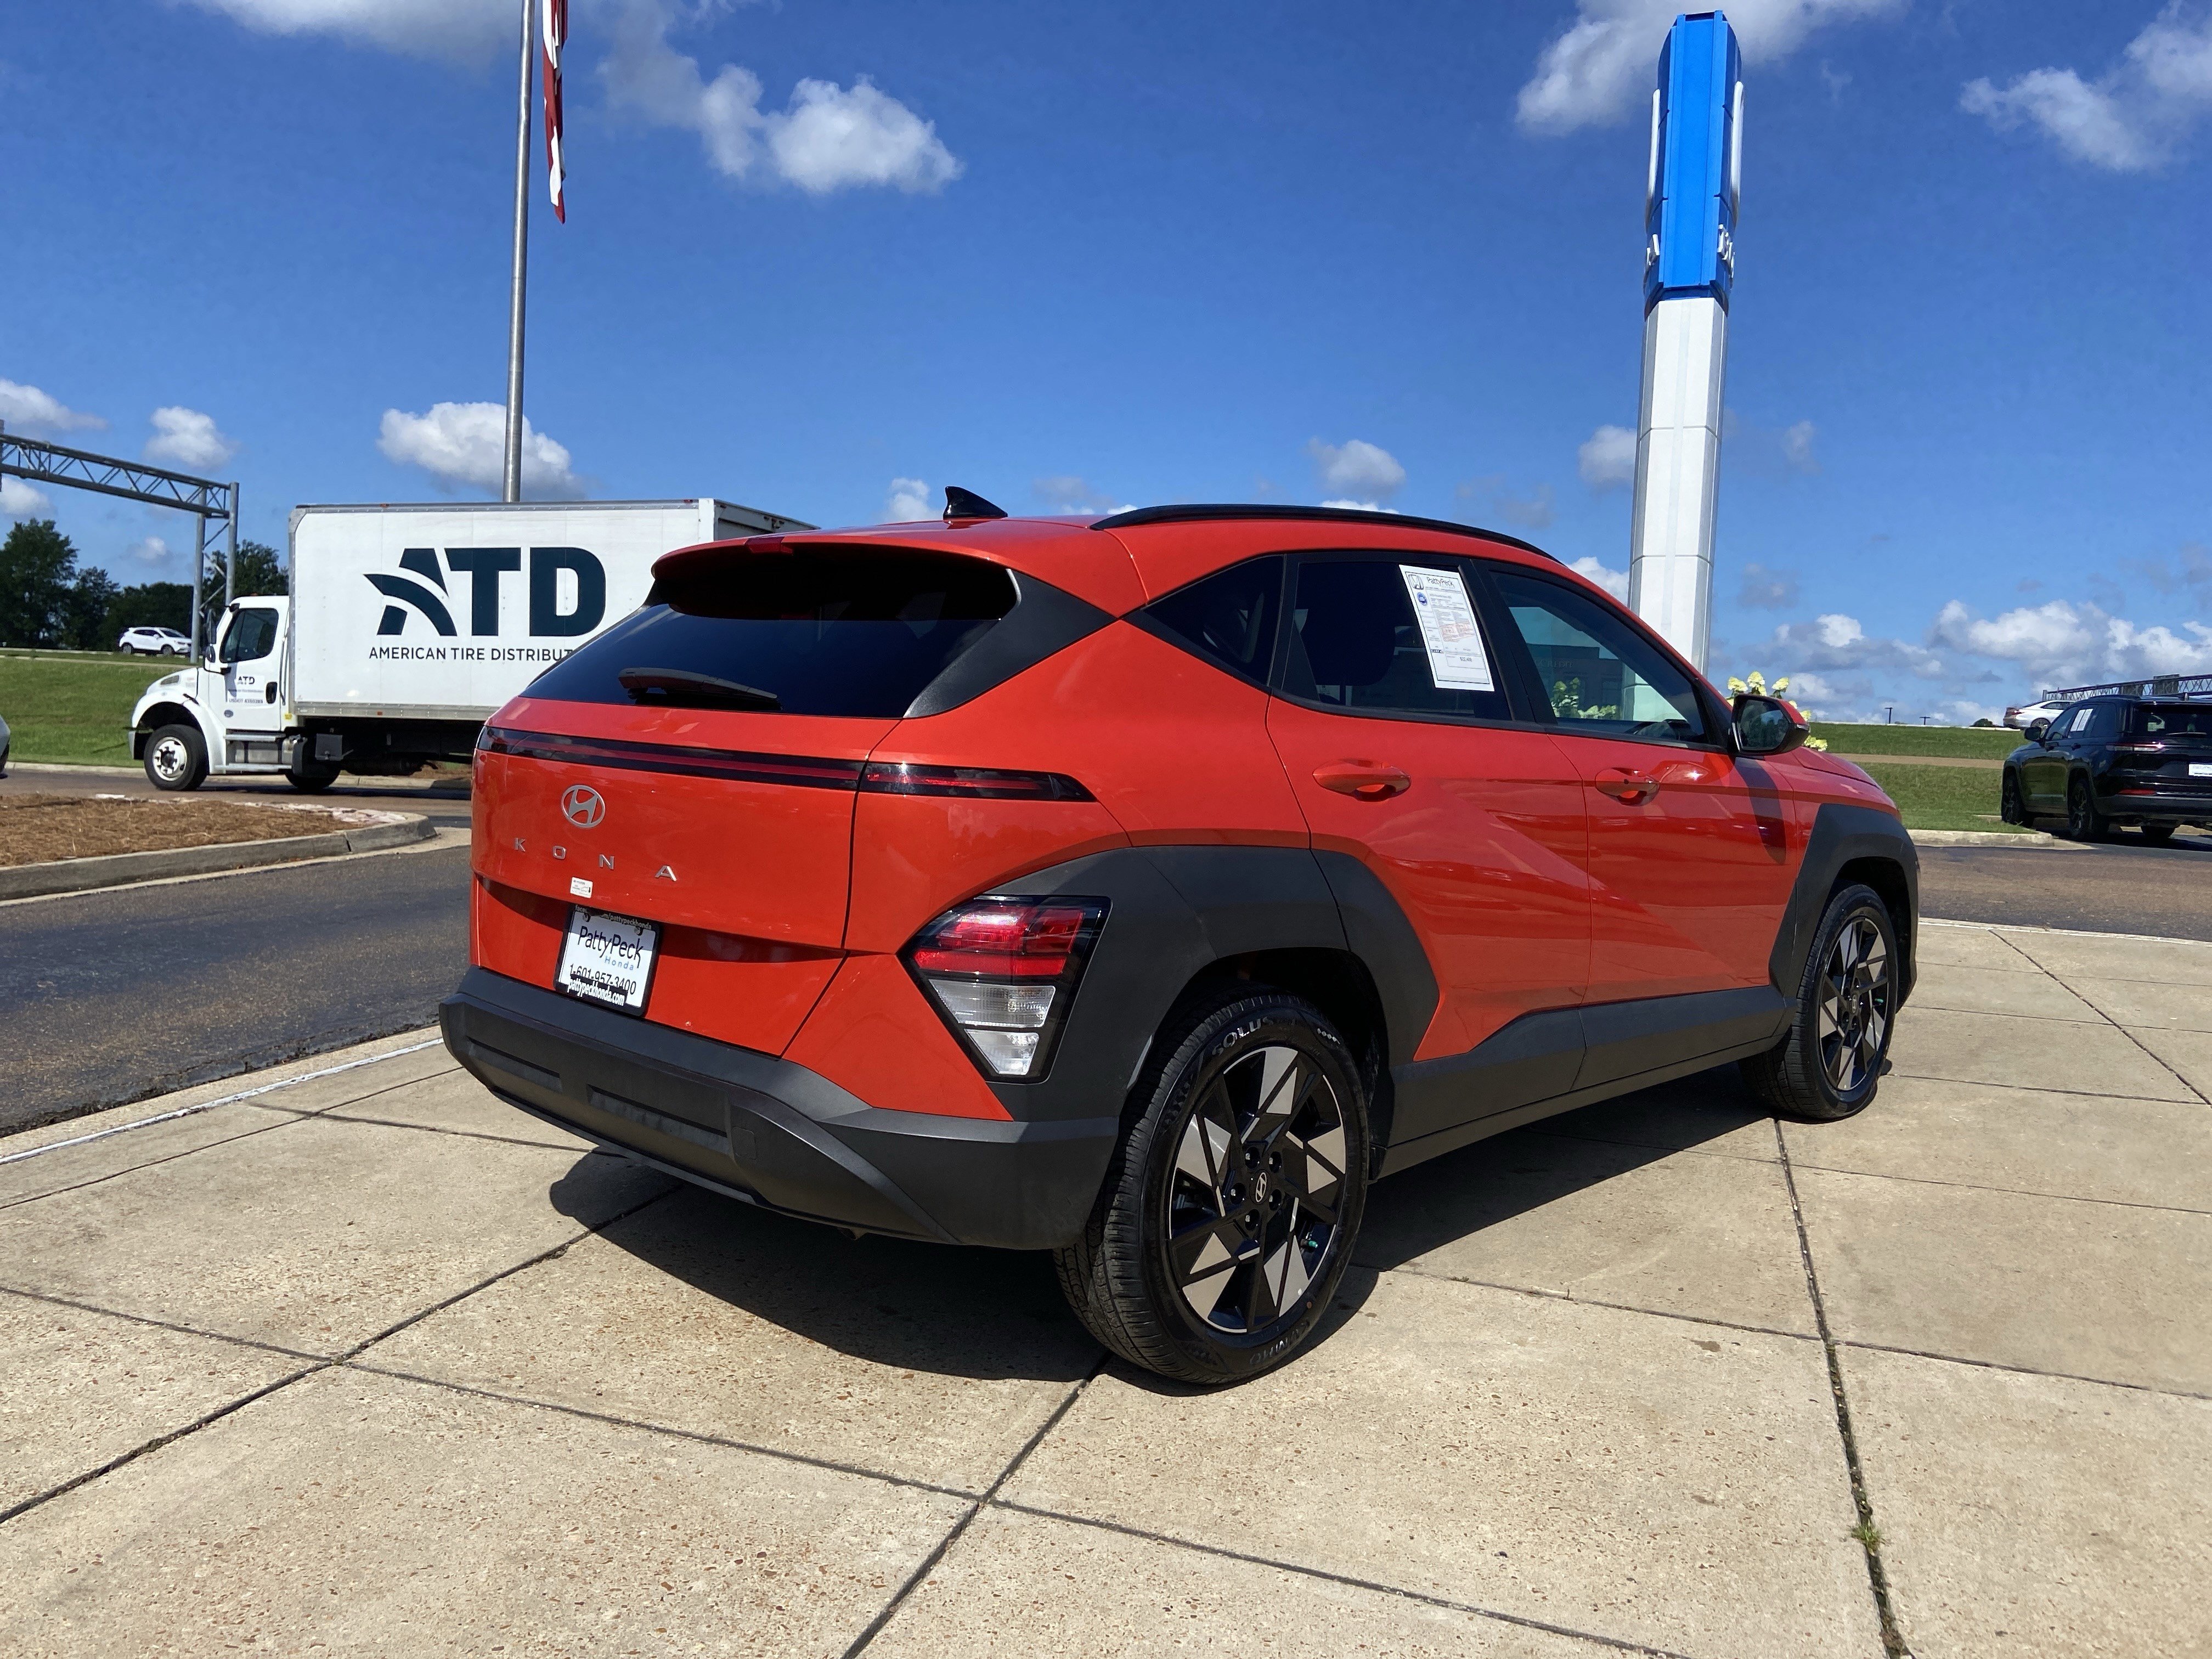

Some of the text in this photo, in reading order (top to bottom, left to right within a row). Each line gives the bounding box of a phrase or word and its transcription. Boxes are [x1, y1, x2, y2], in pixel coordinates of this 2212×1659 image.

[364, 547, 606, 636] ATD
[369, 647, 446, 660] AMERICAN
[451, 648, 485, 661] TIRE
[237, 676, 255, 685] ATD
[514, 837, 678, 882] KONA
[578, 925, 644, 969] PattyPeck
[604, 955, 634, 971] Honda
[567, 977, 625, 1006] pattypeckhonda.com
[569, 963, 637, 995] 1-601-957-3400
[1211, 1015, 1274, 1057] SOLUS
